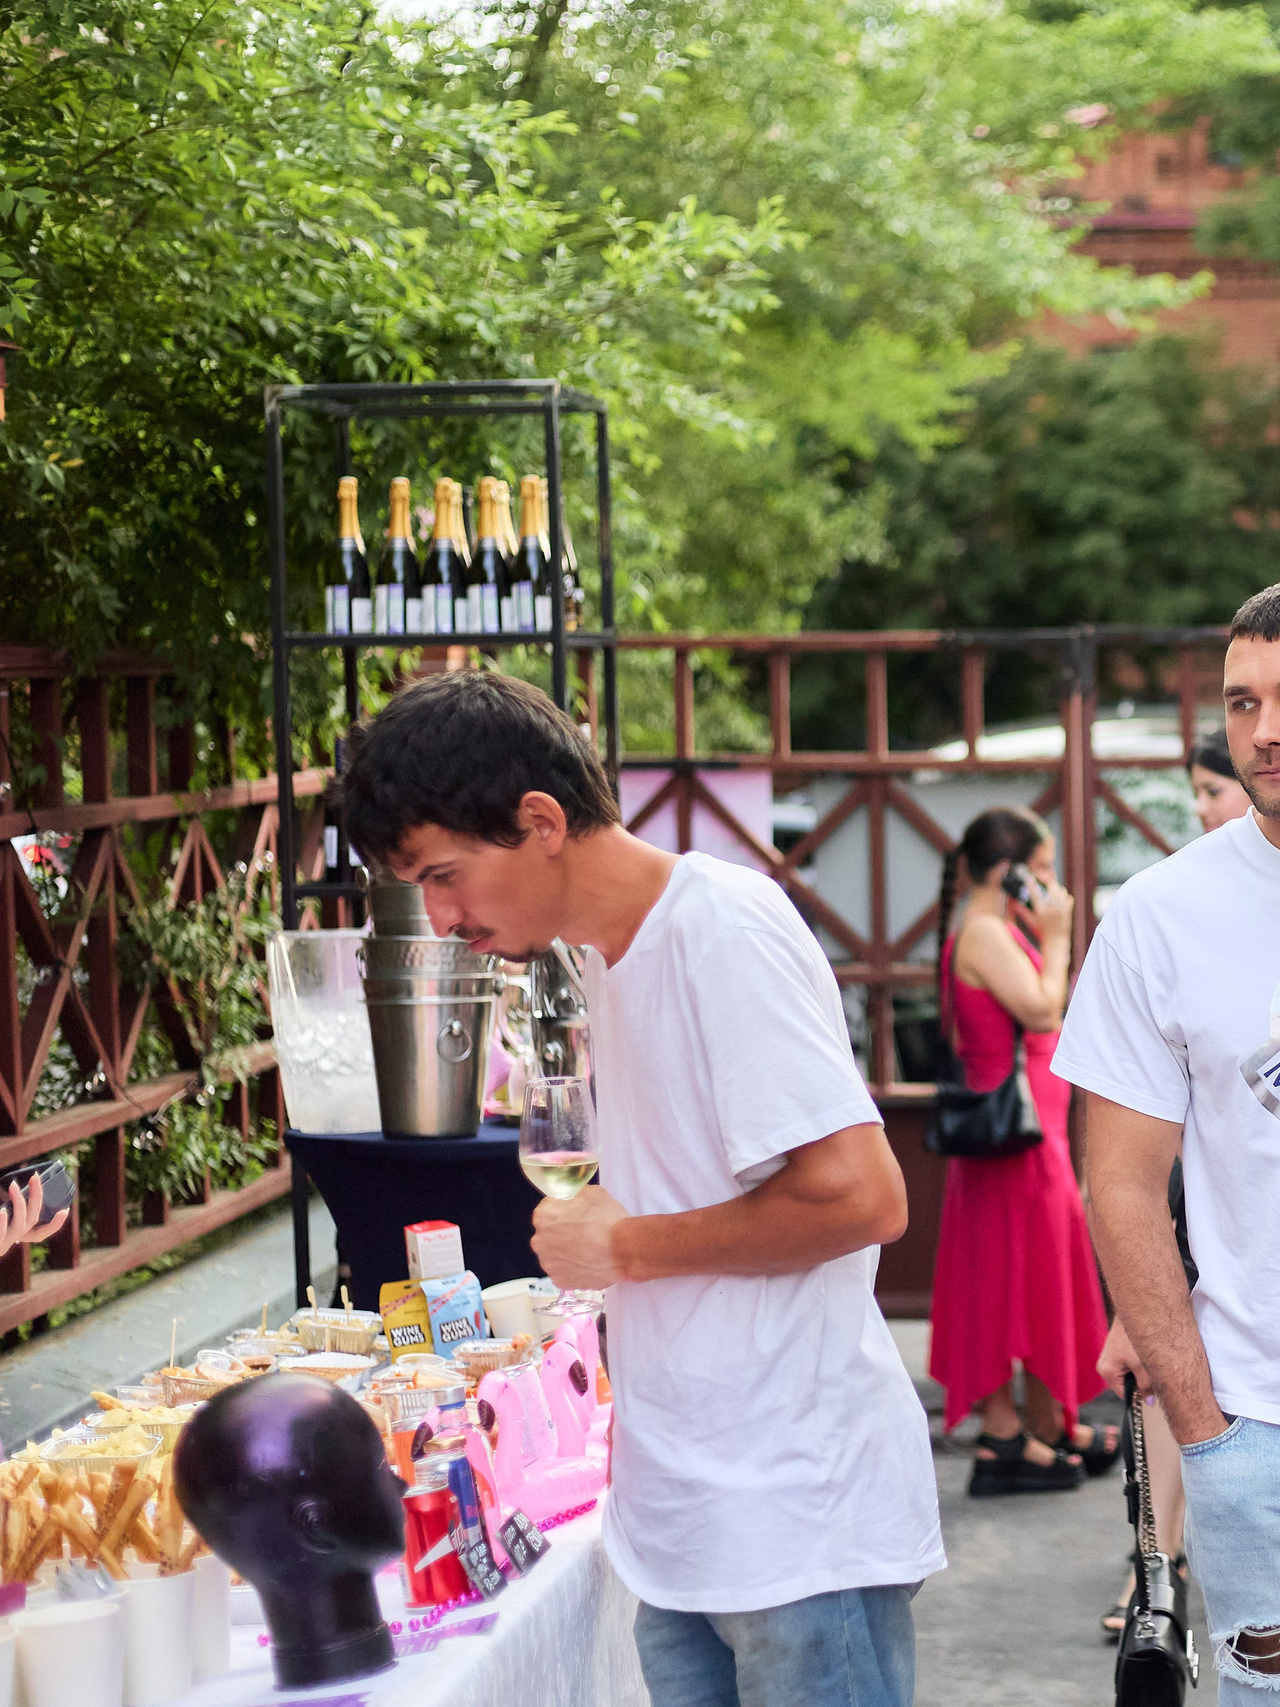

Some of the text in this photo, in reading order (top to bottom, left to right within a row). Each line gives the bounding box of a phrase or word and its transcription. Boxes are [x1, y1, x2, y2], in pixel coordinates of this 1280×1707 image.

[390, 1324, 421, 1338] WINE
[440, 1318, 470, 1333] WINE
[393, 1333, 425, 1348] GUMS
[442, 1326, 474, 1342] GUMS
